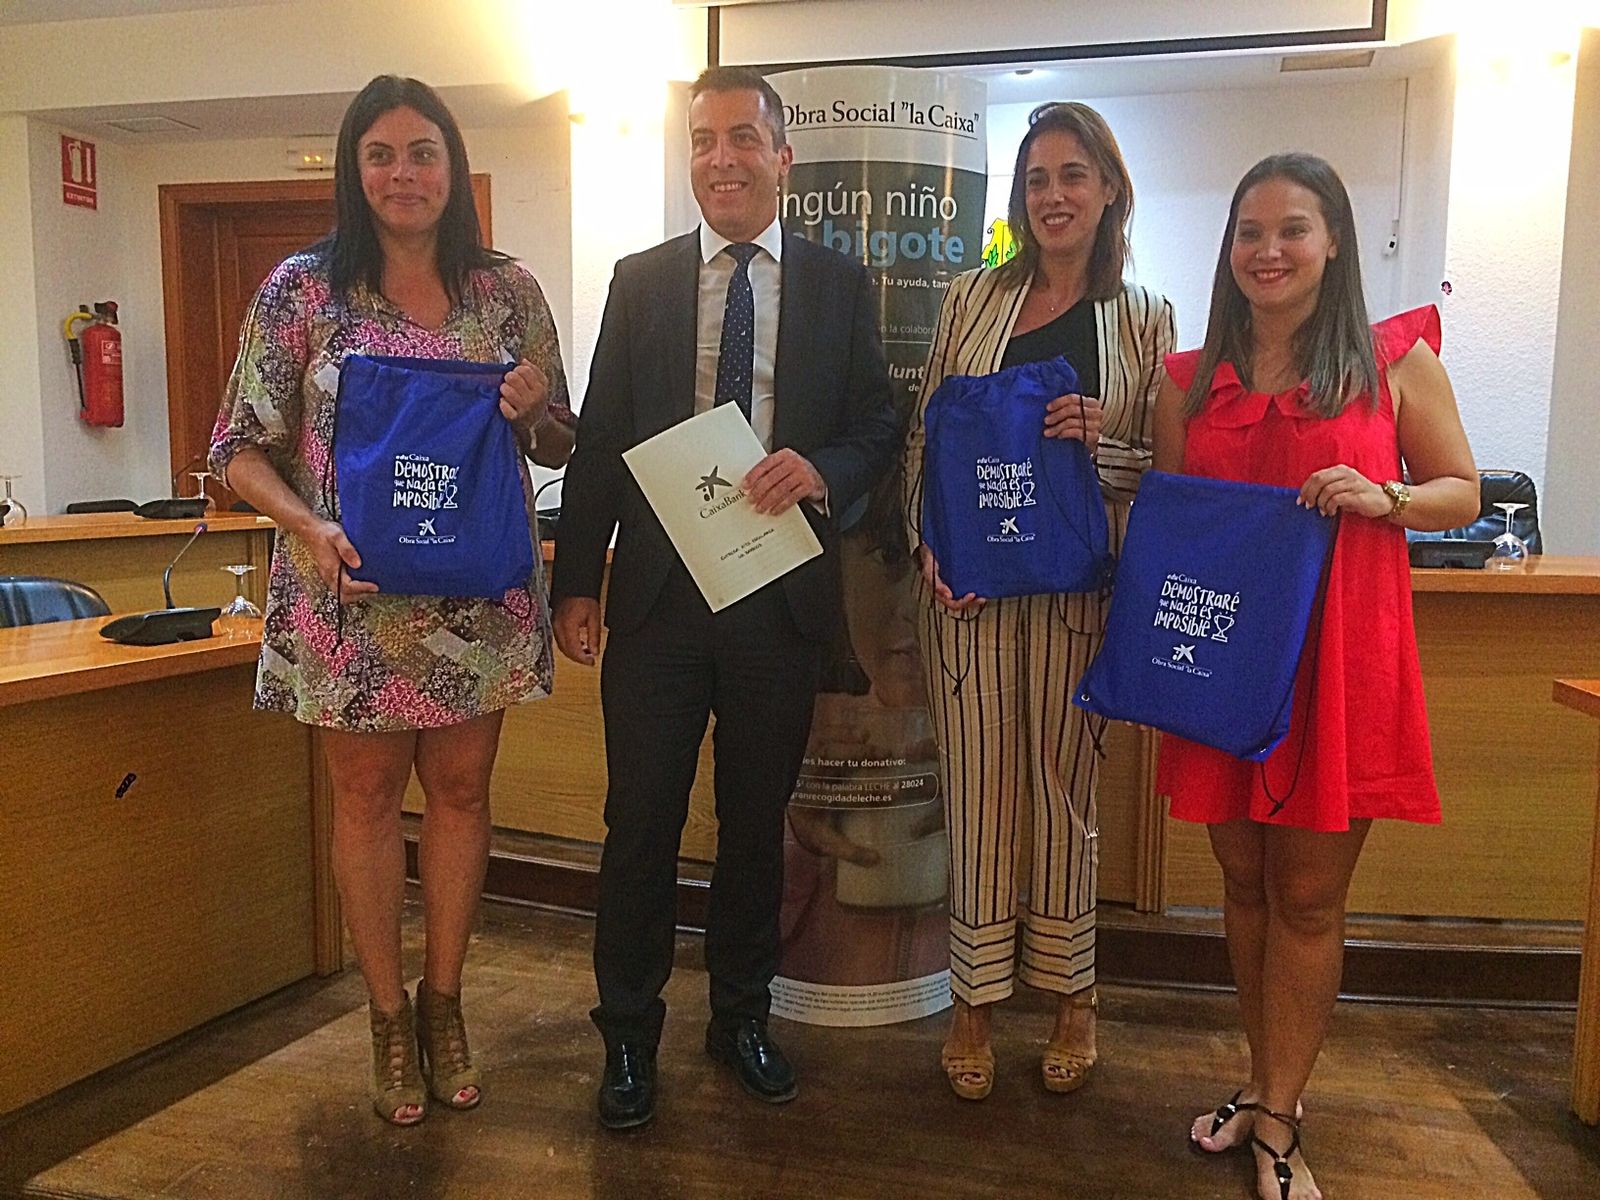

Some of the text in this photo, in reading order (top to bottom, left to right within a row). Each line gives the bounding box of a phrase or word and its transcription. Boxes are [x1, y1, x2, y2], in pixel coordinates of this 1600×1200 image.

[783, 104, 826, 127] Obra
[832, 100, 895, 122] Social
[886, 183, 957, 221] niño
[823, 219, 965, 268] bigote
[882, 276, 894, 286] Tu
[896, 277, 930, 289] ayuda,
[932, 279, 951, 289] tam
[699, 489, 748, 519] CaixaBank
[817, 757, 845, 768] hacer
[847, 759, 859, 768] tu
[860, 758, 906, 768] donativo:
[901, 778, 924, 789] 28024
